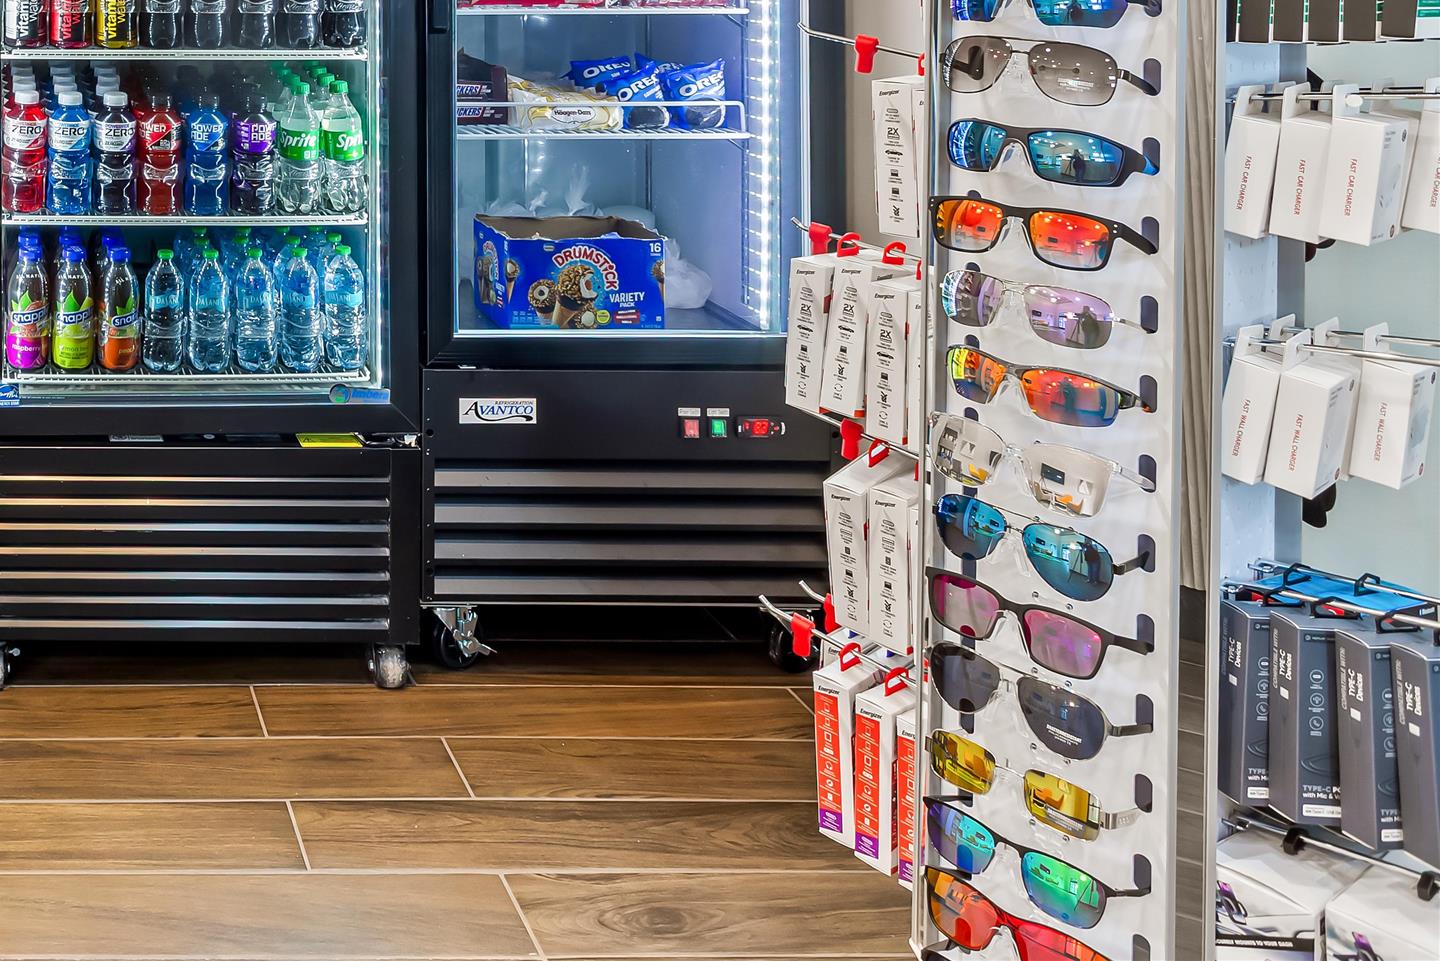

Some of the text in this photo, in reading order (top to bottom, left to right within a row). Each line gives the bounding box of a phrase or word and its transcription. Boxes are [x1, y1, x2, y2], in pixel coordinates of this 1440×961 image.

[879, 89, 900, 97] Energizer
[12, 125, 42, 135] ZERO
[55, 126, 85, 136] ZERO
[105, 128, 135, 136] ZERO
[280, 132, 317, 149] Sprite
[1298, 159, 1306, 174] FAST
[1350, 158, 1358, 173] FAST
[1236, 183, 1247, 210] CHARGER
[1294, 187, 1303, 216] CHARGER
[1344, 187, 1354, 216] CHARGER
[649, 243, 661, 252] 16
[553, 246, 618, 290] DRUMSTICK
[610, 292, 645, 303] VARIETY
[462, 401, 533, 417] AVANTCO
[1243, 399, 1251, 413] FAST
[1379, 402, 1388, 417] FAST
[1238, 415, 1247, 429] WALL
[1295, 413, 1304, 428] FAST
[1377, 418, 1385, 434] WALL
[1356, 672, 1364, 702] Devices
[1413, 686, 1422, 716] Devices
[860, 708, 883, 720] Energizer
[1303, 784, 1331, 793] TYPE-C
